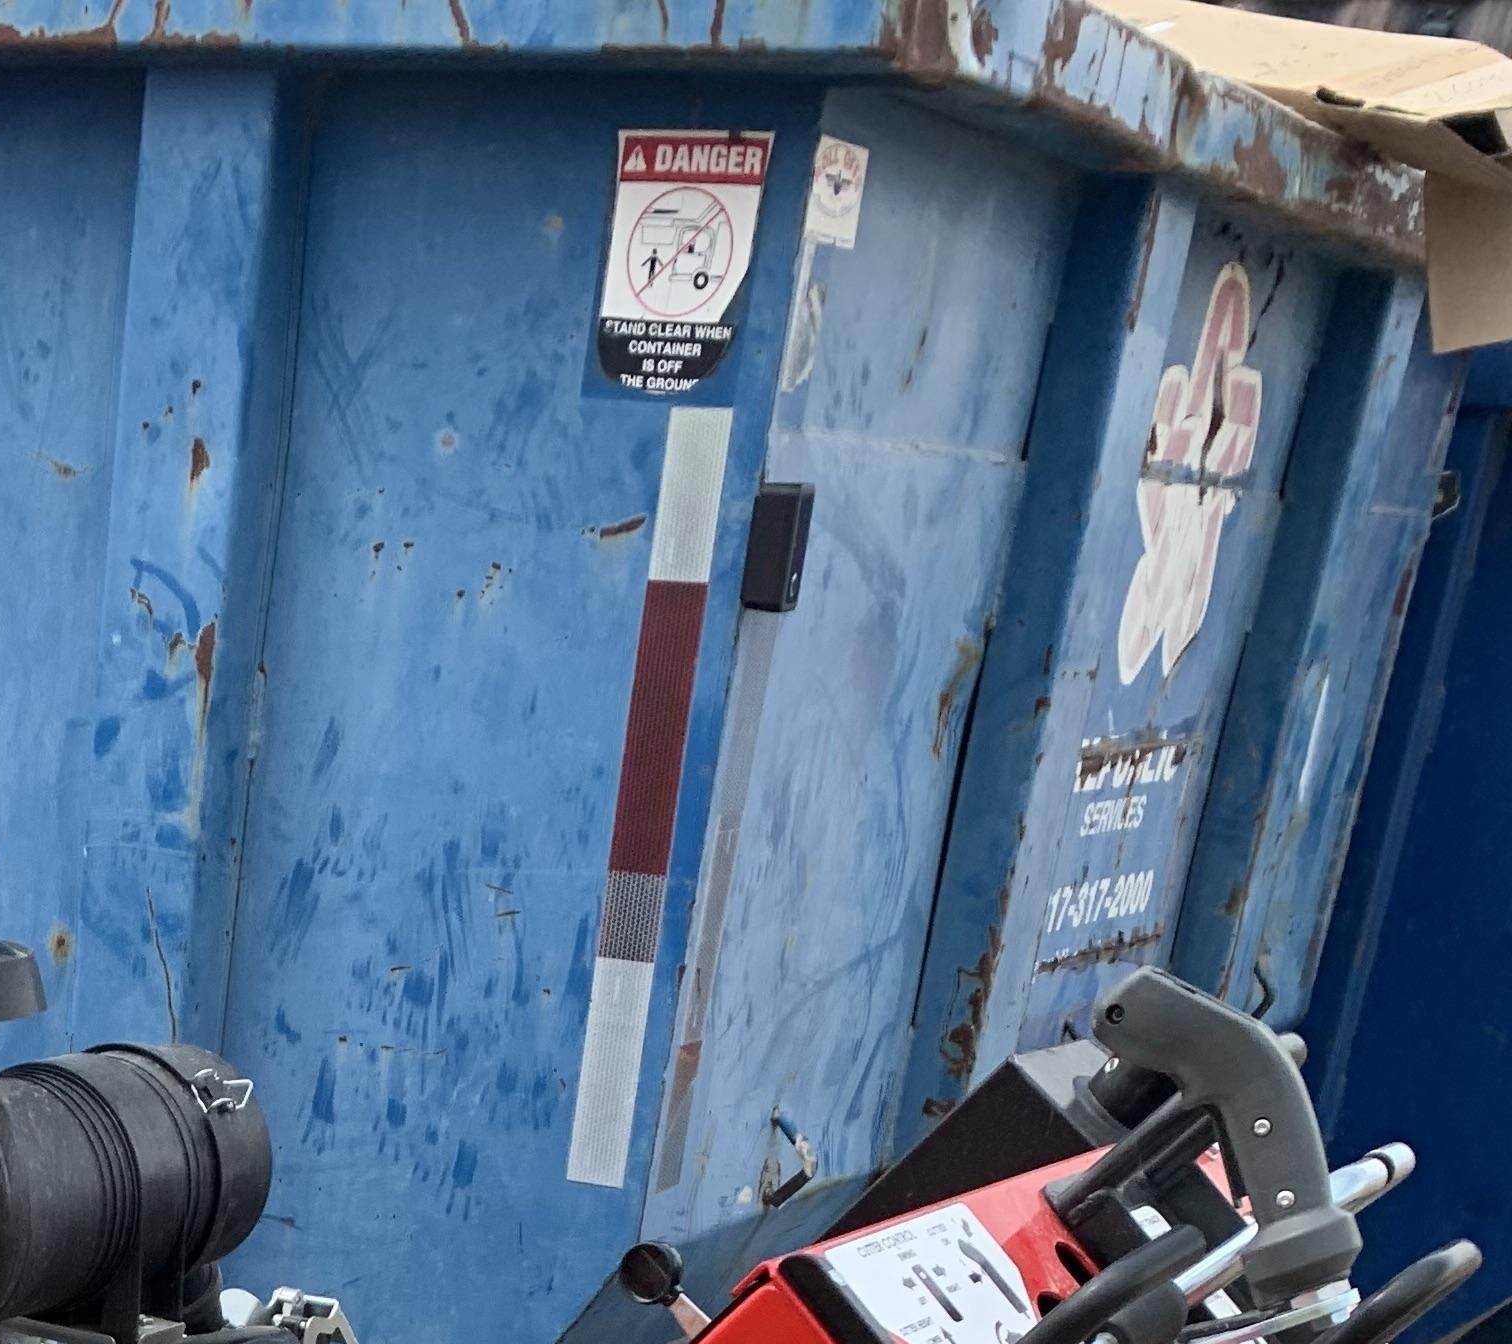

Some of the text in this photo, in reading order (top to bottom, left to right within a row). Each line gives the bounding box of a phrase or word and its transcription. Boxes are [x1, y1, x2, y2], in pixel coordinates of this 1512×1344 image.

[655, 144, 762, 176] DANGER
[605, 320, 734, 340] STAND CLEAR WHEN
[628, 340, 703, 357] CONTAINER
[642, 358, 684, 374] IS OFF
[619, 373, 644, 388] THE
[1079, 795, 1148, 836] SERVICES
